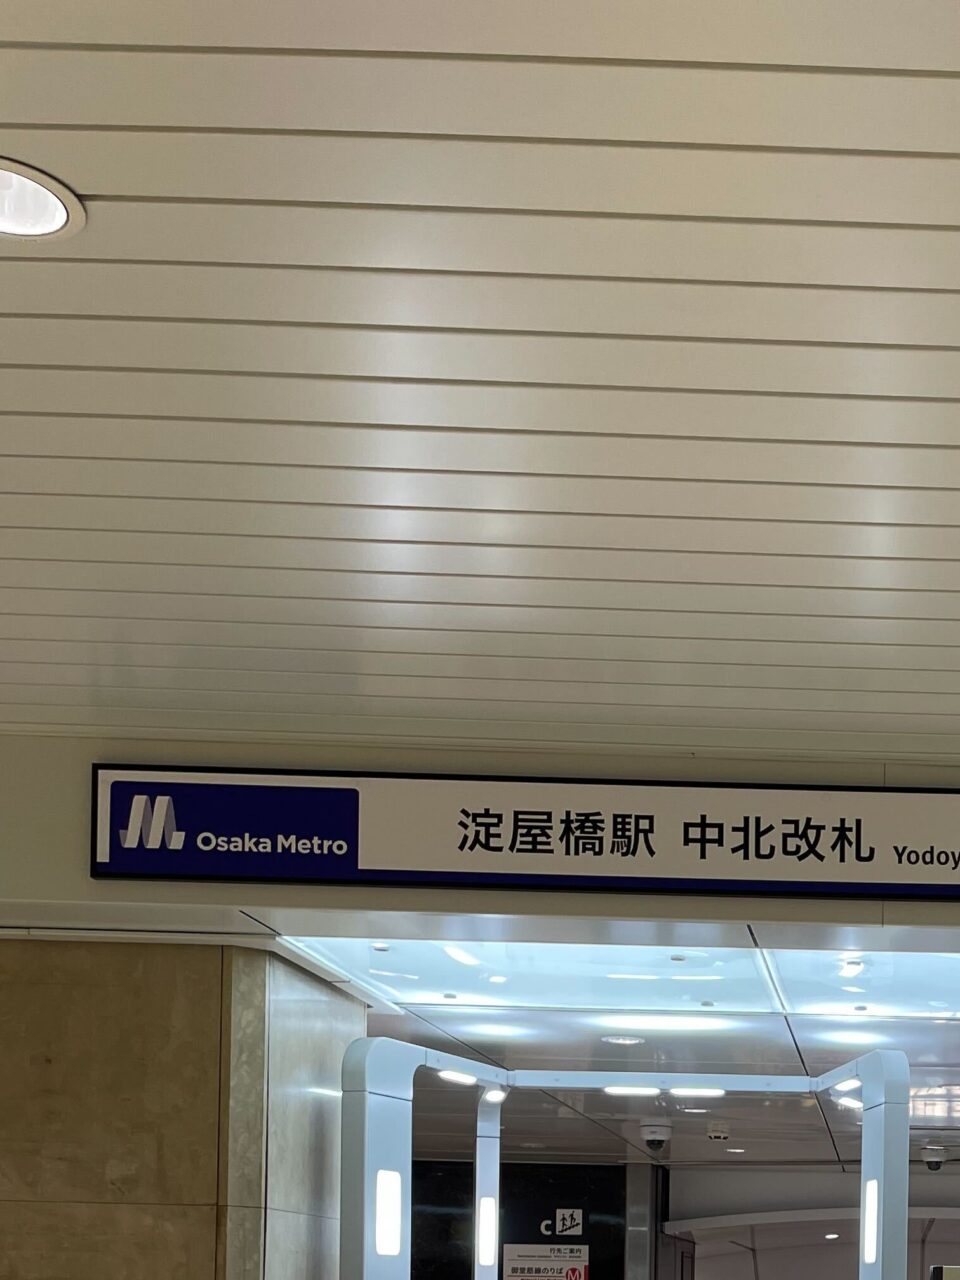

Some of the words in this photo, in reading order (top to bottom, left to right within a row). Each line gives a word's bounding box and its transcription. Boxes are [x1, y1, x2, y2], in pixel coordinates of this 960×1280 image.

[196, 832, 272, 854] Osaka
[277, 834, 348, 856] Metro
[457, 808, 656, 858] 淀屋橋駅
[683, 813, 875, 863] 中北改札
[540, 1219, 552, 1236] C
